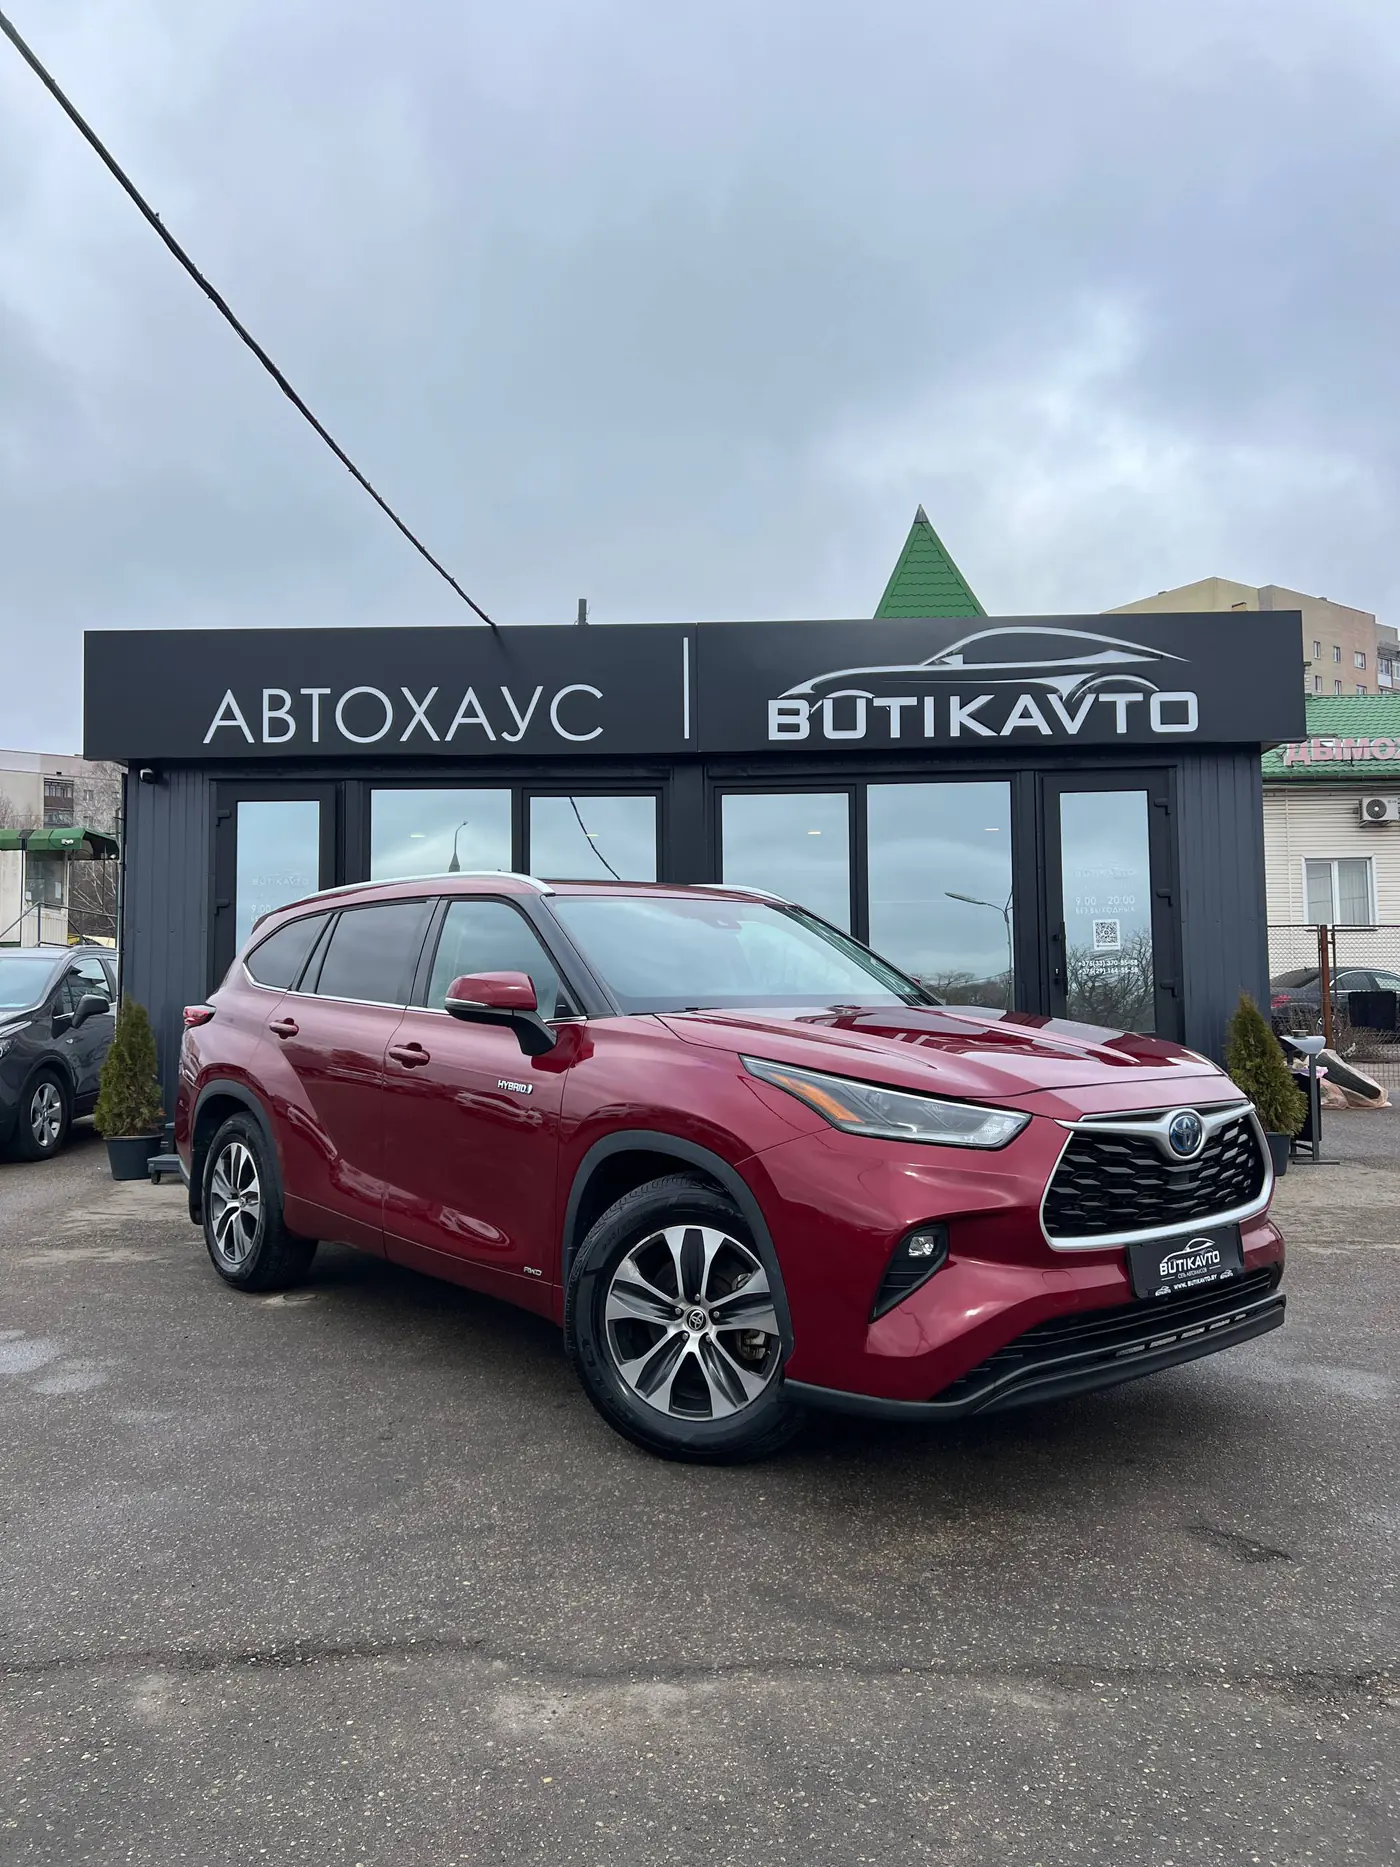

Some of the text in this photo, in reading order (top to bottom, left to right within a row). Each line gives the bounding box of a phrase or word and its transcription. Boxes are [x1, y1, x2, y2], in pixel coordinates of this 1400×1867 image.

[203, 684, 604, 744] АВТОХАУС
[768, 691, 1199, 740] BUTIKAVTO
[497, 1079, 527, 1093] HYBRID
[1160, 1250, 1220, 1275] BUTIKAVTO
